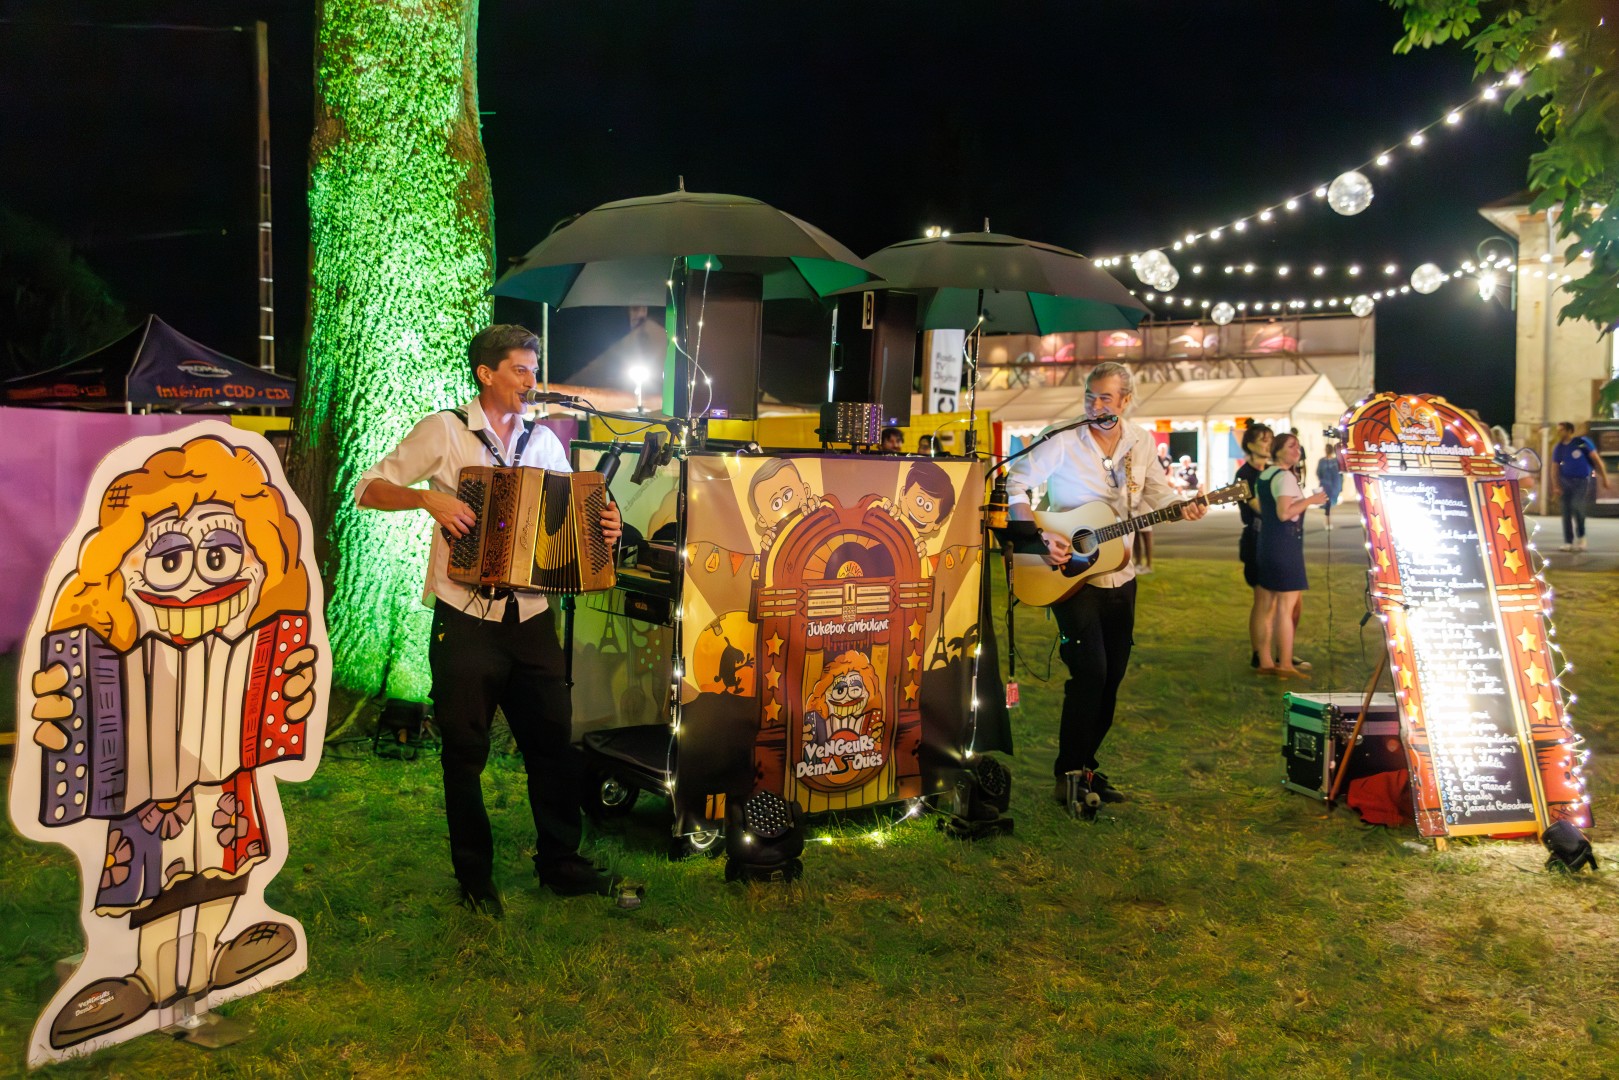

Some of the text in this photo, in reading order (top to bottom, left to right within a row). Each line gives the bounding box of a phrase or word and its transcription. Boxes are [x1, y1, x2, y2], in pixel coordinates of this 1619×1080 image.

[222, 384, 256, 398] CDD
[265, 387, 290, 400] CDI
[1364, 441, 1378, 452] Le
[1425, 444, 1475, 456] Ambulant
[808, 620, 846, 637] Jukebox
